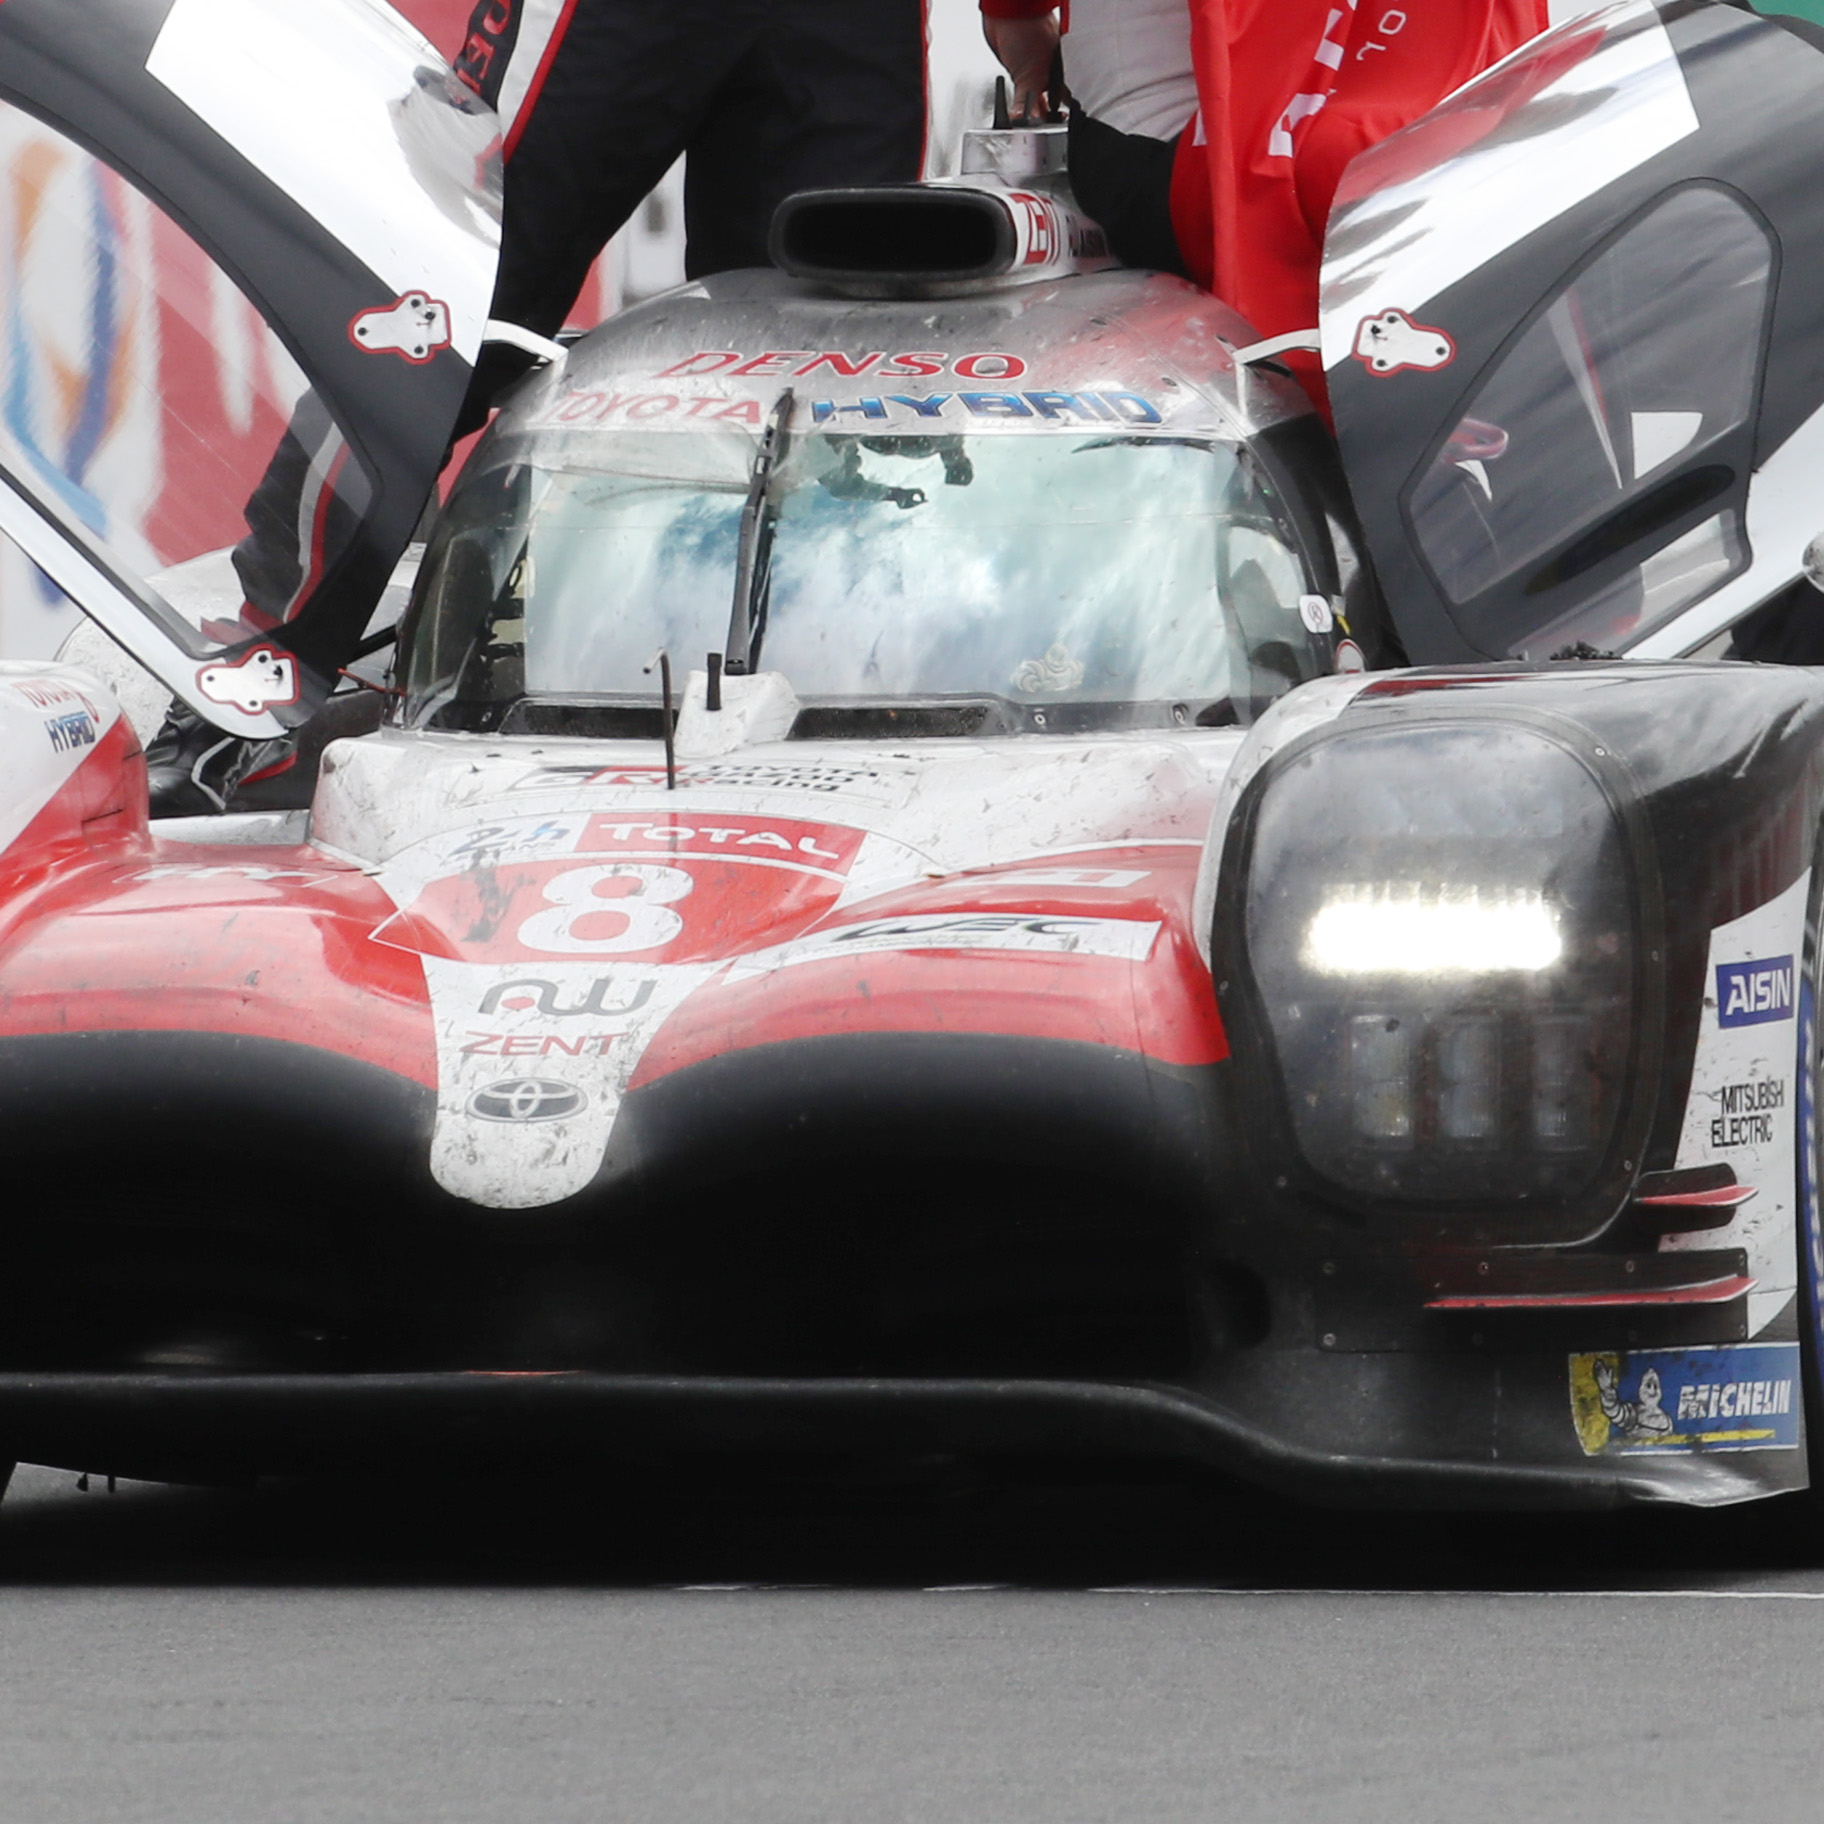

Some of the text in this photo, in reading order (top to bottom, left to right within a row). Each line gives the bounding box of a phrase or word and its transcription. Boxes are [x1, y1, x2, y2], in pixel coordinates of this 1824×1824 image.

[661, 350, 1027, 380] DENSO
[552, 390, 1164, 426] TOYOTA HYBRID
[43, 709, 97, 754] HYBRID
[599, 822, 841, 860] TOTAL
[517, 863, 695, 954] 8
[1726, 967, 1791, 1015] AISIN
[459, 1030, 630, 1056] ZENT
[1677, 1379, 1792, 1421] MICHELIN
